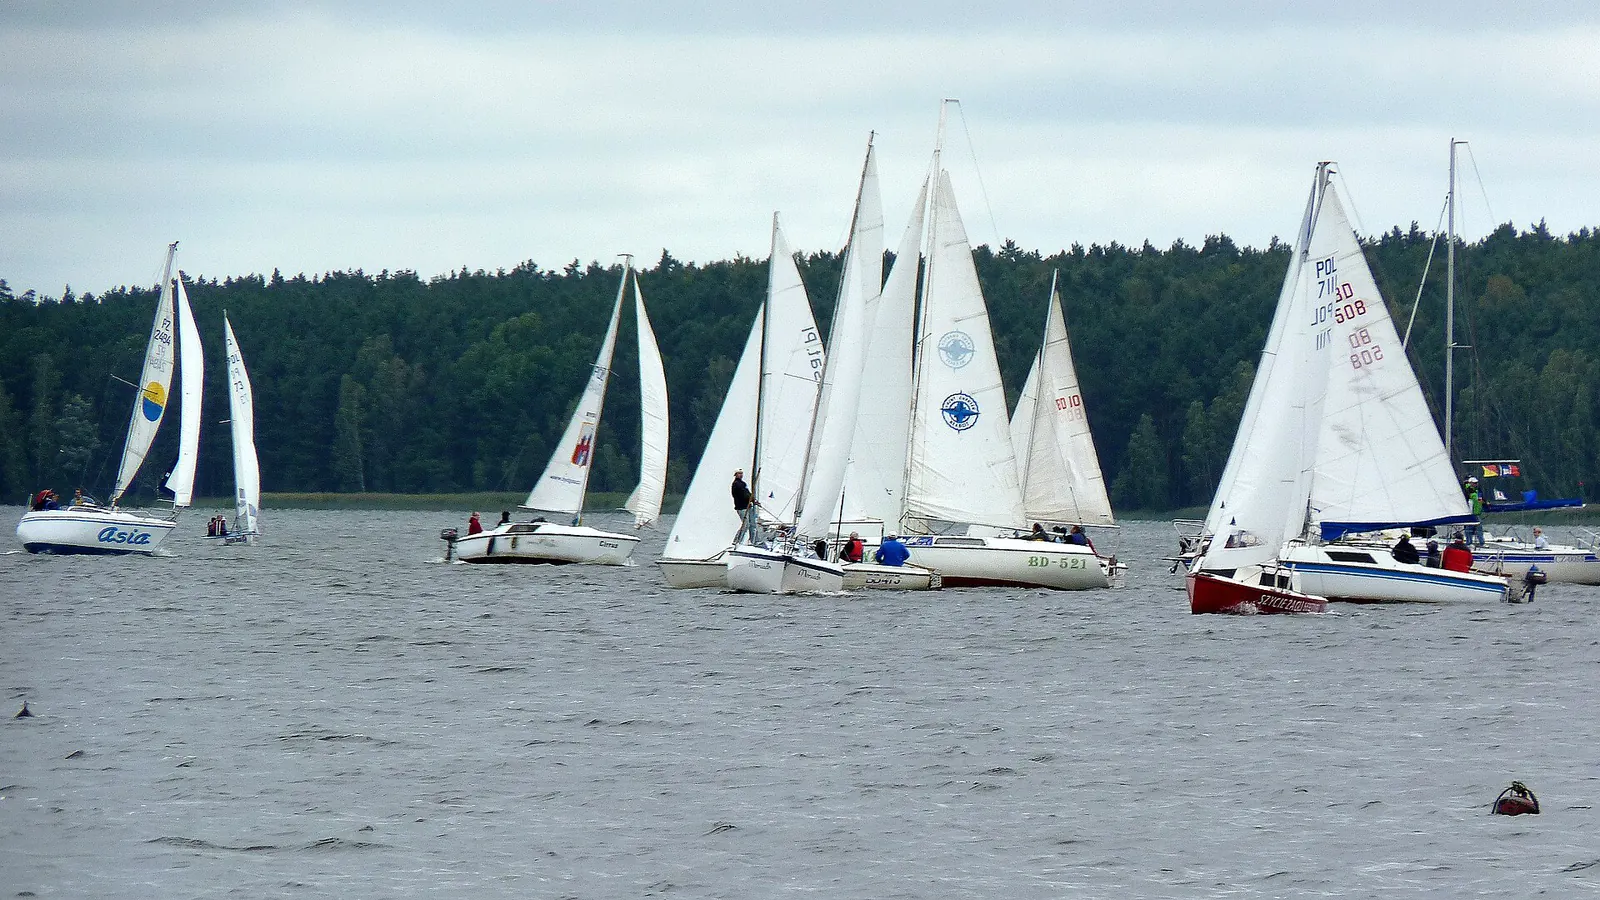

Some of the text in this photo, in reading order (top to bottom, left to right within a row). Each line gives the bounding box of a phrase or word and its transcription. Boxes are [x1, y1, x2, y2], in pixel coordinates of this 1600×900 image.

[1316, 256, 1338, 278] POL
[1335, 300, 1366, 324] 508
[161, 318, 171, 331] FZ
[1068, 394, 1081, 408] 10
[1027, 556, 1087, 569] BD-521
